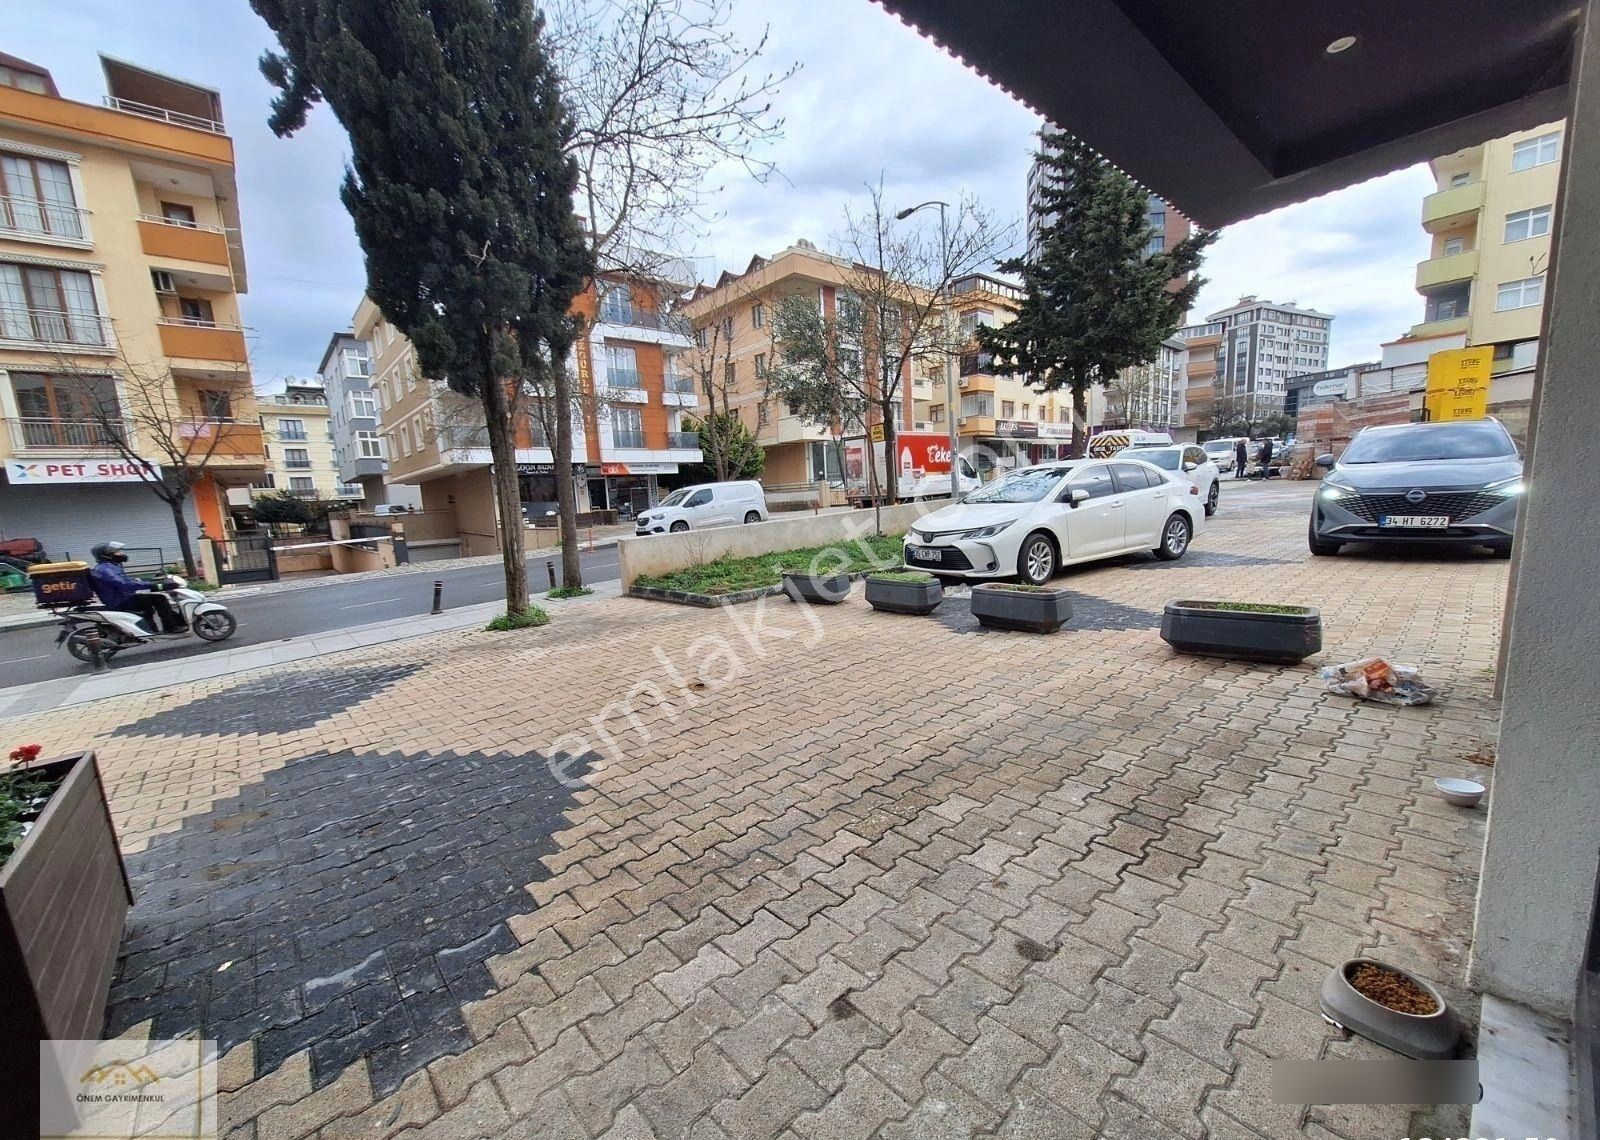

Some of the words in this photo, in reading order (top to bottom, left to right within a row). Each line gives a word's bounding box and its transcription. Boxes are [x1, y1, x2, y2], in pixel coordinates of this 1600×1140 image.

[45, 464, 85, 476] PET
[1387, 517, 1398, 525] 34
[1402, 517, 1415, 525] HT
[1420, 517, 1447, 526] 6272
[41, 581, 78, 594] getir
